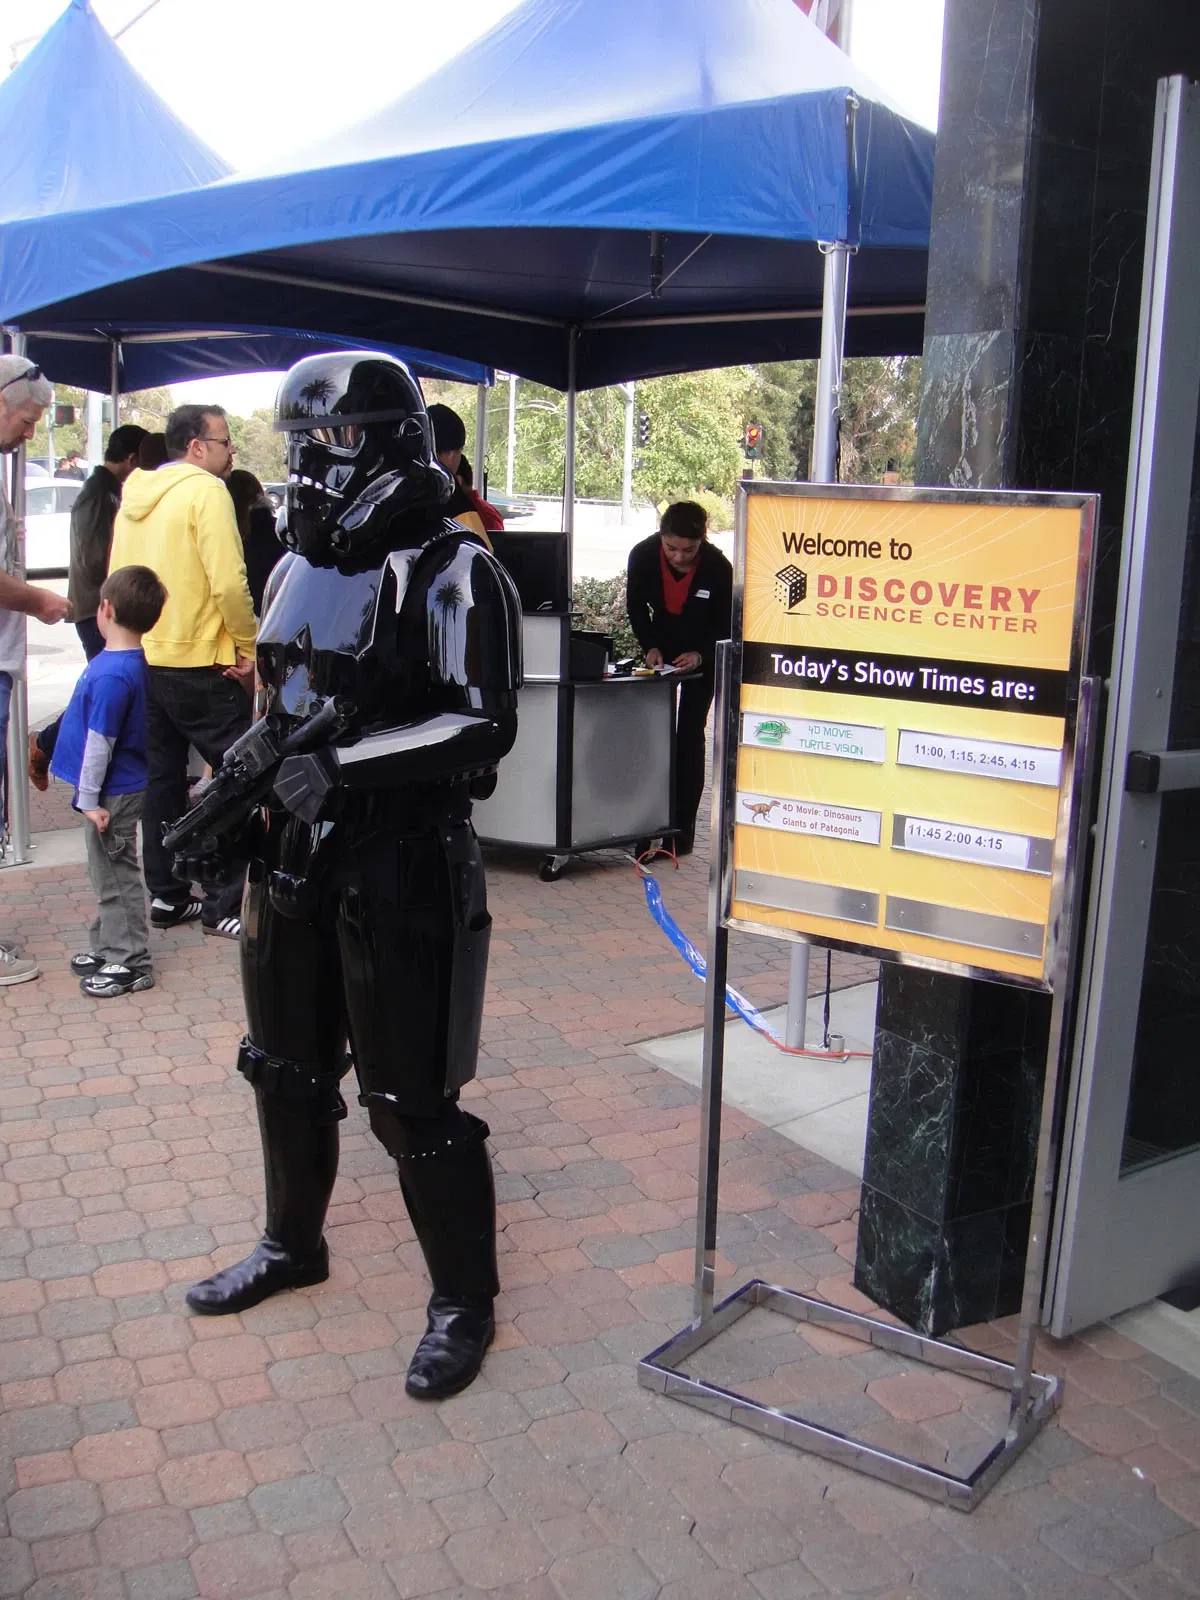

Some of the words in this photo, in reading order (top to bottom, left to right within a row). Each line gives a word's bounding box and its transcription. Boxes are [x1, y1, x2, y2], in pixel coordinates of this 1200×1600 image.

[782, 532, 881, 558] Welcome
[889, 537, 913, 561] to
[817, 574, 1041, 614] DISCOVERY
[816, 602, 923, 625] SCIENCE
[934, 612, 1038, 634] CENTER
[770, 653, 848, 683] Today's
[854, 661, 915, 688] Show
[919, 667, 985, 695] Times
[991, 680, 1036, 701] are:
[808, 725, 821, 735] 4D
[823, 727, 853, 739] MOVIE
[799, 739, 831, 751] TURTLE
[833, 743, 864, 755] VISION
[915, 744, 946, 759] 11:00,
[950, 749, 976, 764] 1:15,
[980, 753, 1007, 768] 2:45,
[1011, 758, 1036, 771] 4:15
[782, 803, 794, 812] 4D
[796, 806, 821, 817] Movie:
[823, 809, 862, 823] Dinosaurs
[782, 817, 807, 829] Giants
[809, 821, 818, 830] of
[820, 823, 860, 836] Patagonia
[908, 824, 941, 840] 11:45
[944, 830, 972, 845] 2:00
[975, 835, 1003, 850] 4:15
